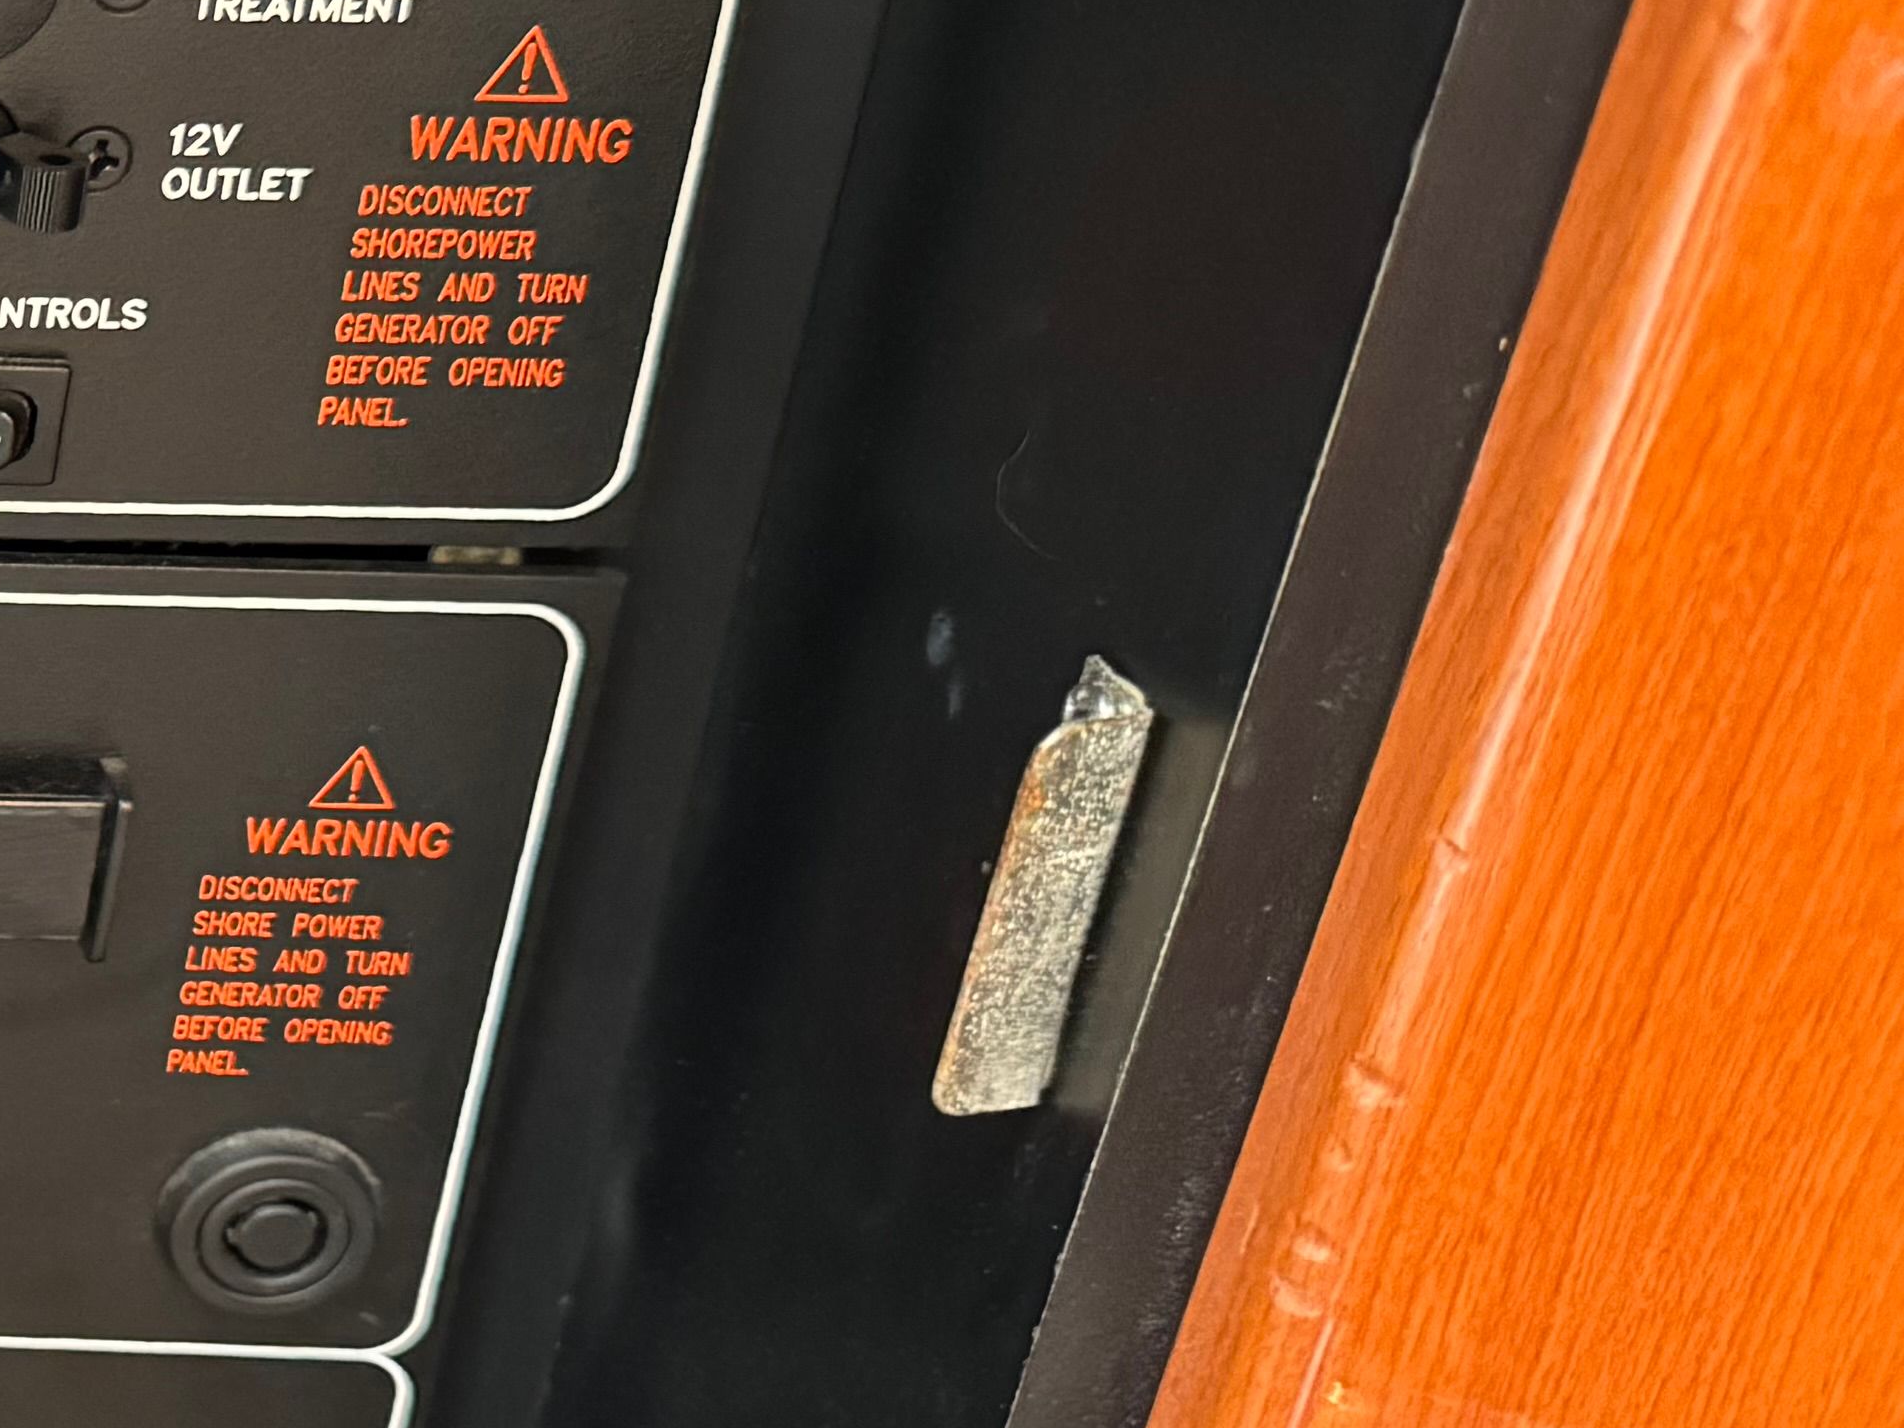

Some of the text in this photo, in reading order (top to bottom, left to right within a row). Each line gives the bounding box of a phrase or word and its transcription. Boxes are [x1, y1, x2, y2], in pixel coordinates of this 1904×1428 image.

[169, 122, 244, 157] 12V
[411, 115, 634, 164] WARNING
[161, 166, 314, 202] OUTLET
[357, 184, 534, 218] DISCONNECT
[350, 227, 539, 262] SHOREPOWER
[340, 270, 590, 305] LINES AND TURN
[335, 312, 565, 346] GENERATOR OFF
[325, 354, 567, 388] BEFORE OPENING
[317, 395, 410, 429] PANEL.
[246, 816, 453, 860] WARNING
[198, 874, 359, 905] DISCONNECT
[193, 909, 385, 942] SHORE POWER
[172, 1014, 394, 1047] BEFORE OPENING
[166, 1048, 250, 1077] PANEL.
